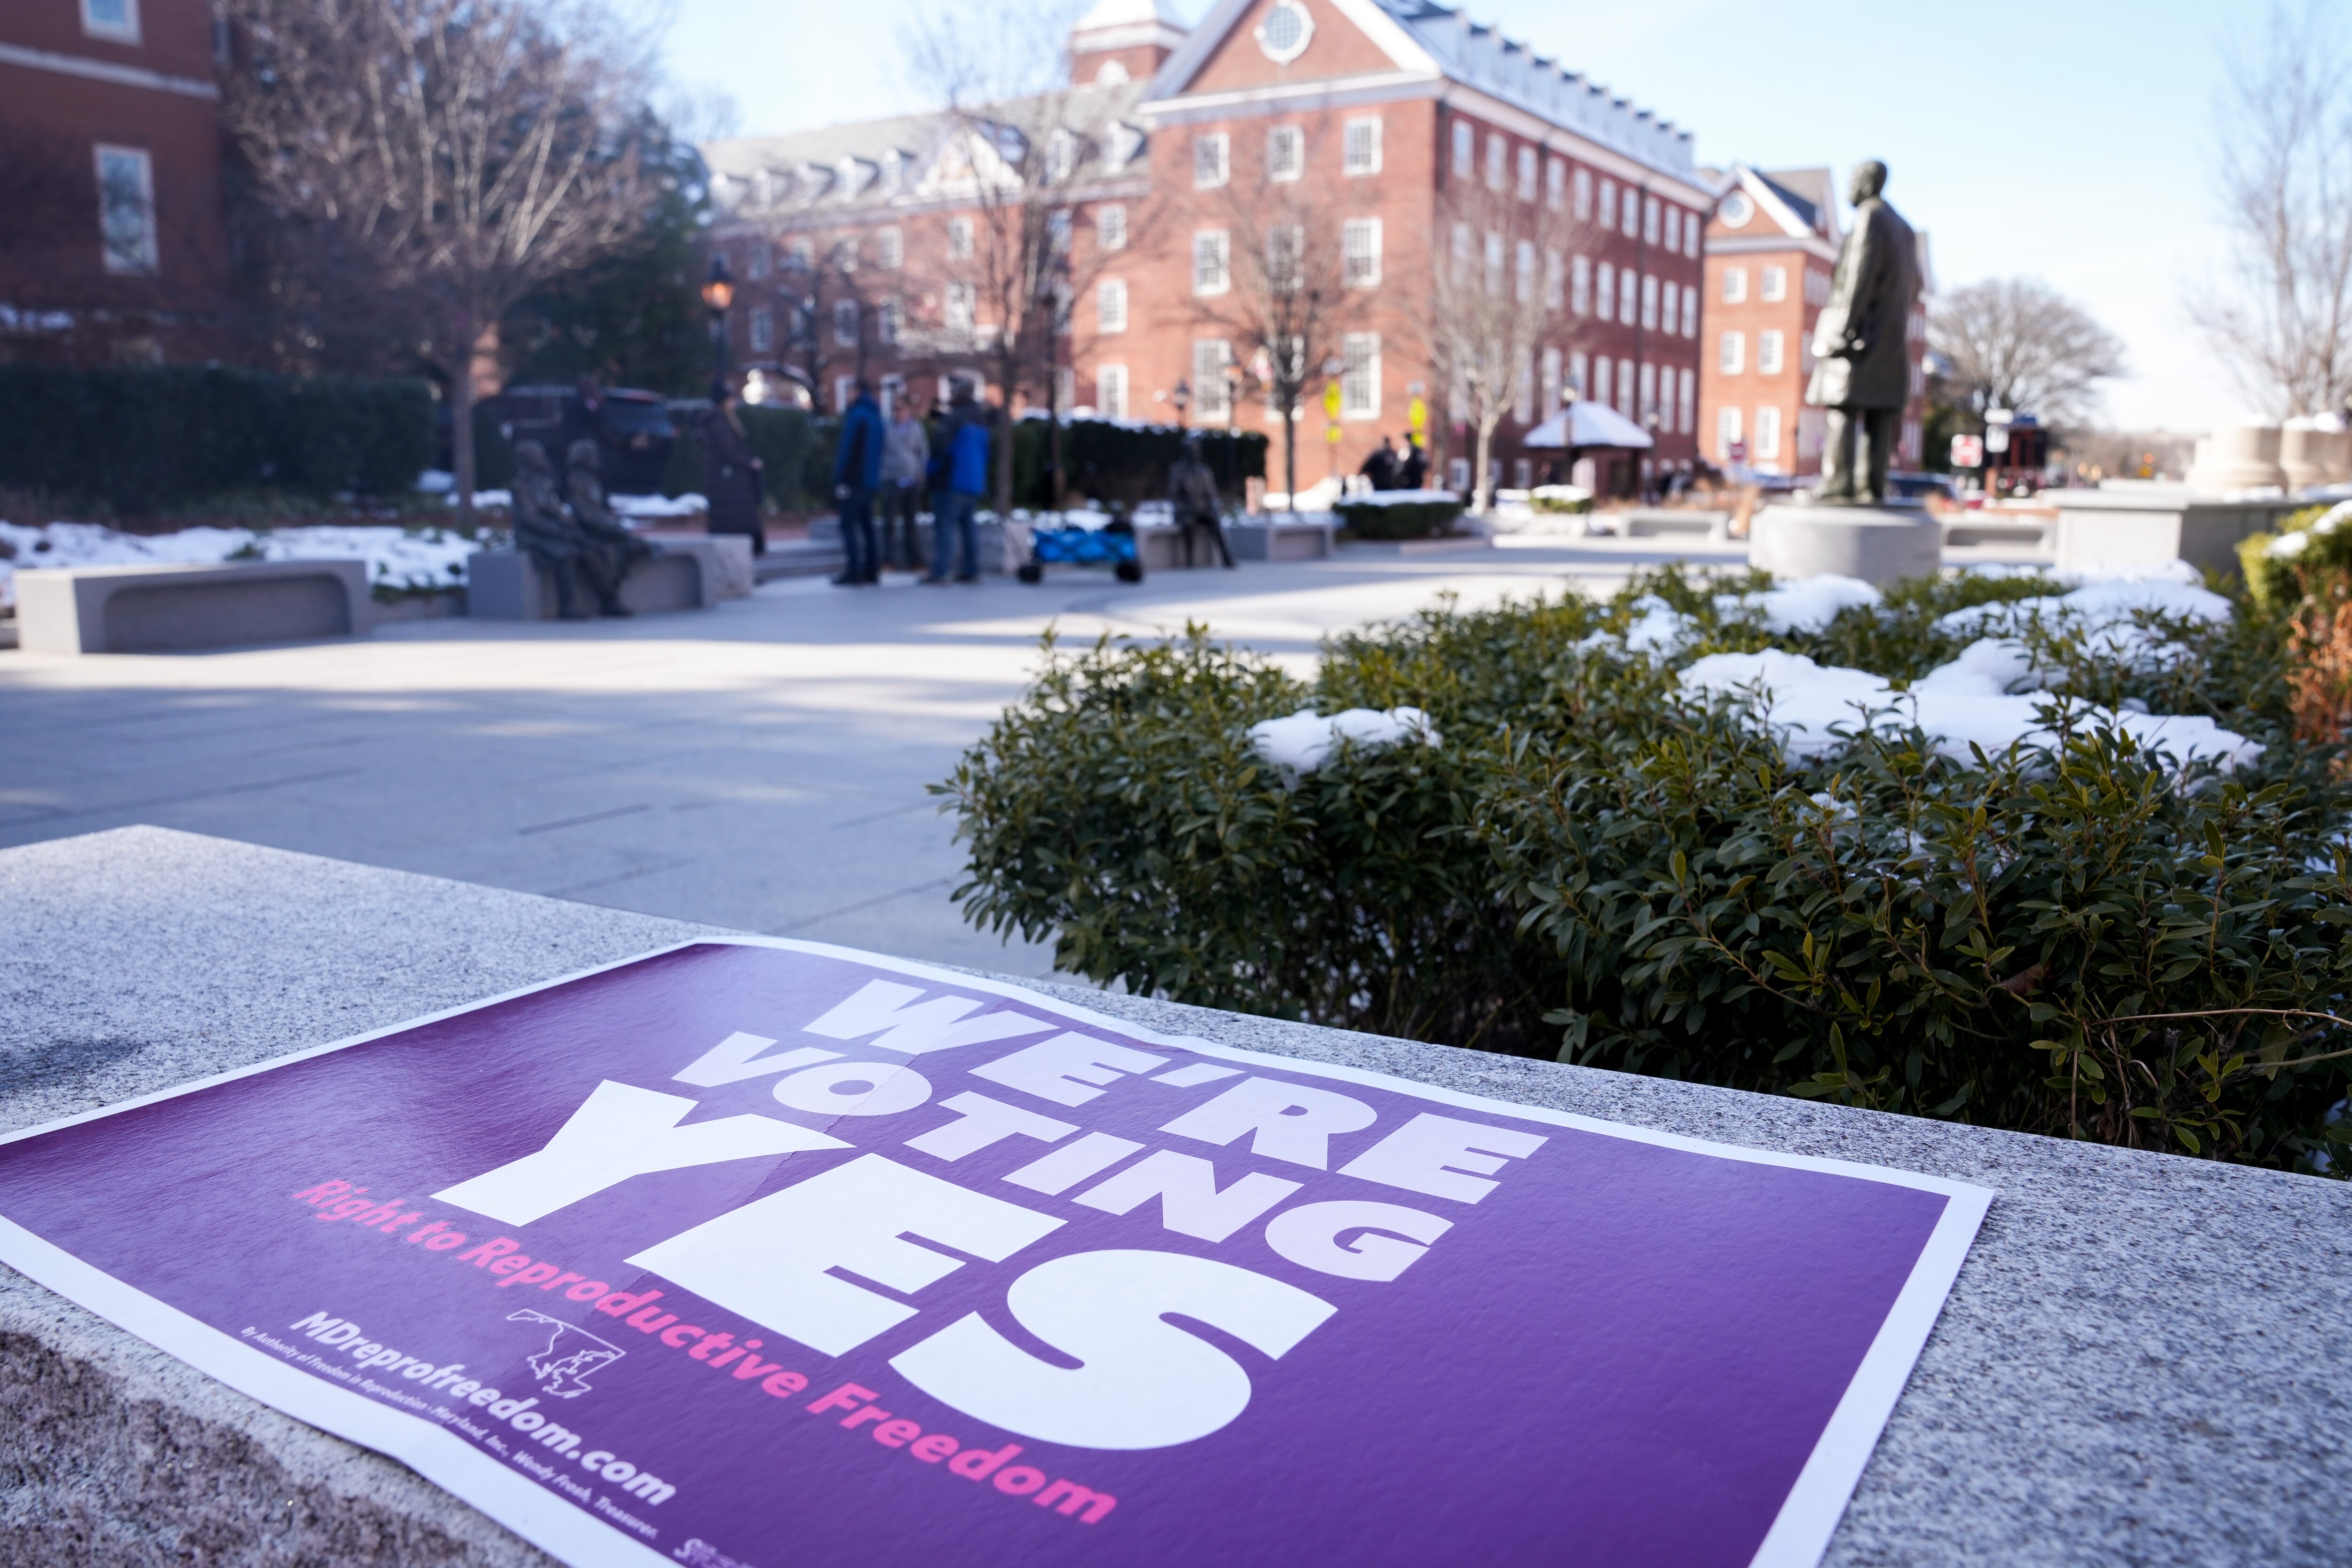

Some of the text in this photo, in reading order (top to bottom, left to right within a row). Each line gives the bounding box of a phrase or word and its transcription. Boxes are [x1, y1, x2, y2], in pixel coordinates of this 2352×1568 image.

[802, 978, 1549, 1205] WE'RE
[671, 1031, 1454, 1281] VOTING
[429, 1079, 1339, 1450] YES
[240, 1326, 258, 1337] By
[252, 1332, 302, 1358] Authority
[293, 1179, 1118, 1525] Right to Reproductive Freedom
[296, 1354, 317, 1363] of
[306, 1356, 352, 1380] Freedom
[347, 1374, 363, 1385] in
[357, 1378, 429, 1411] Reproduction
[288, 1311, 676, 1505] MDreprofreedom.com
[429, 1405, 490, 1441] Maryland,
[511, 1450, 557, 1481] Wendy
